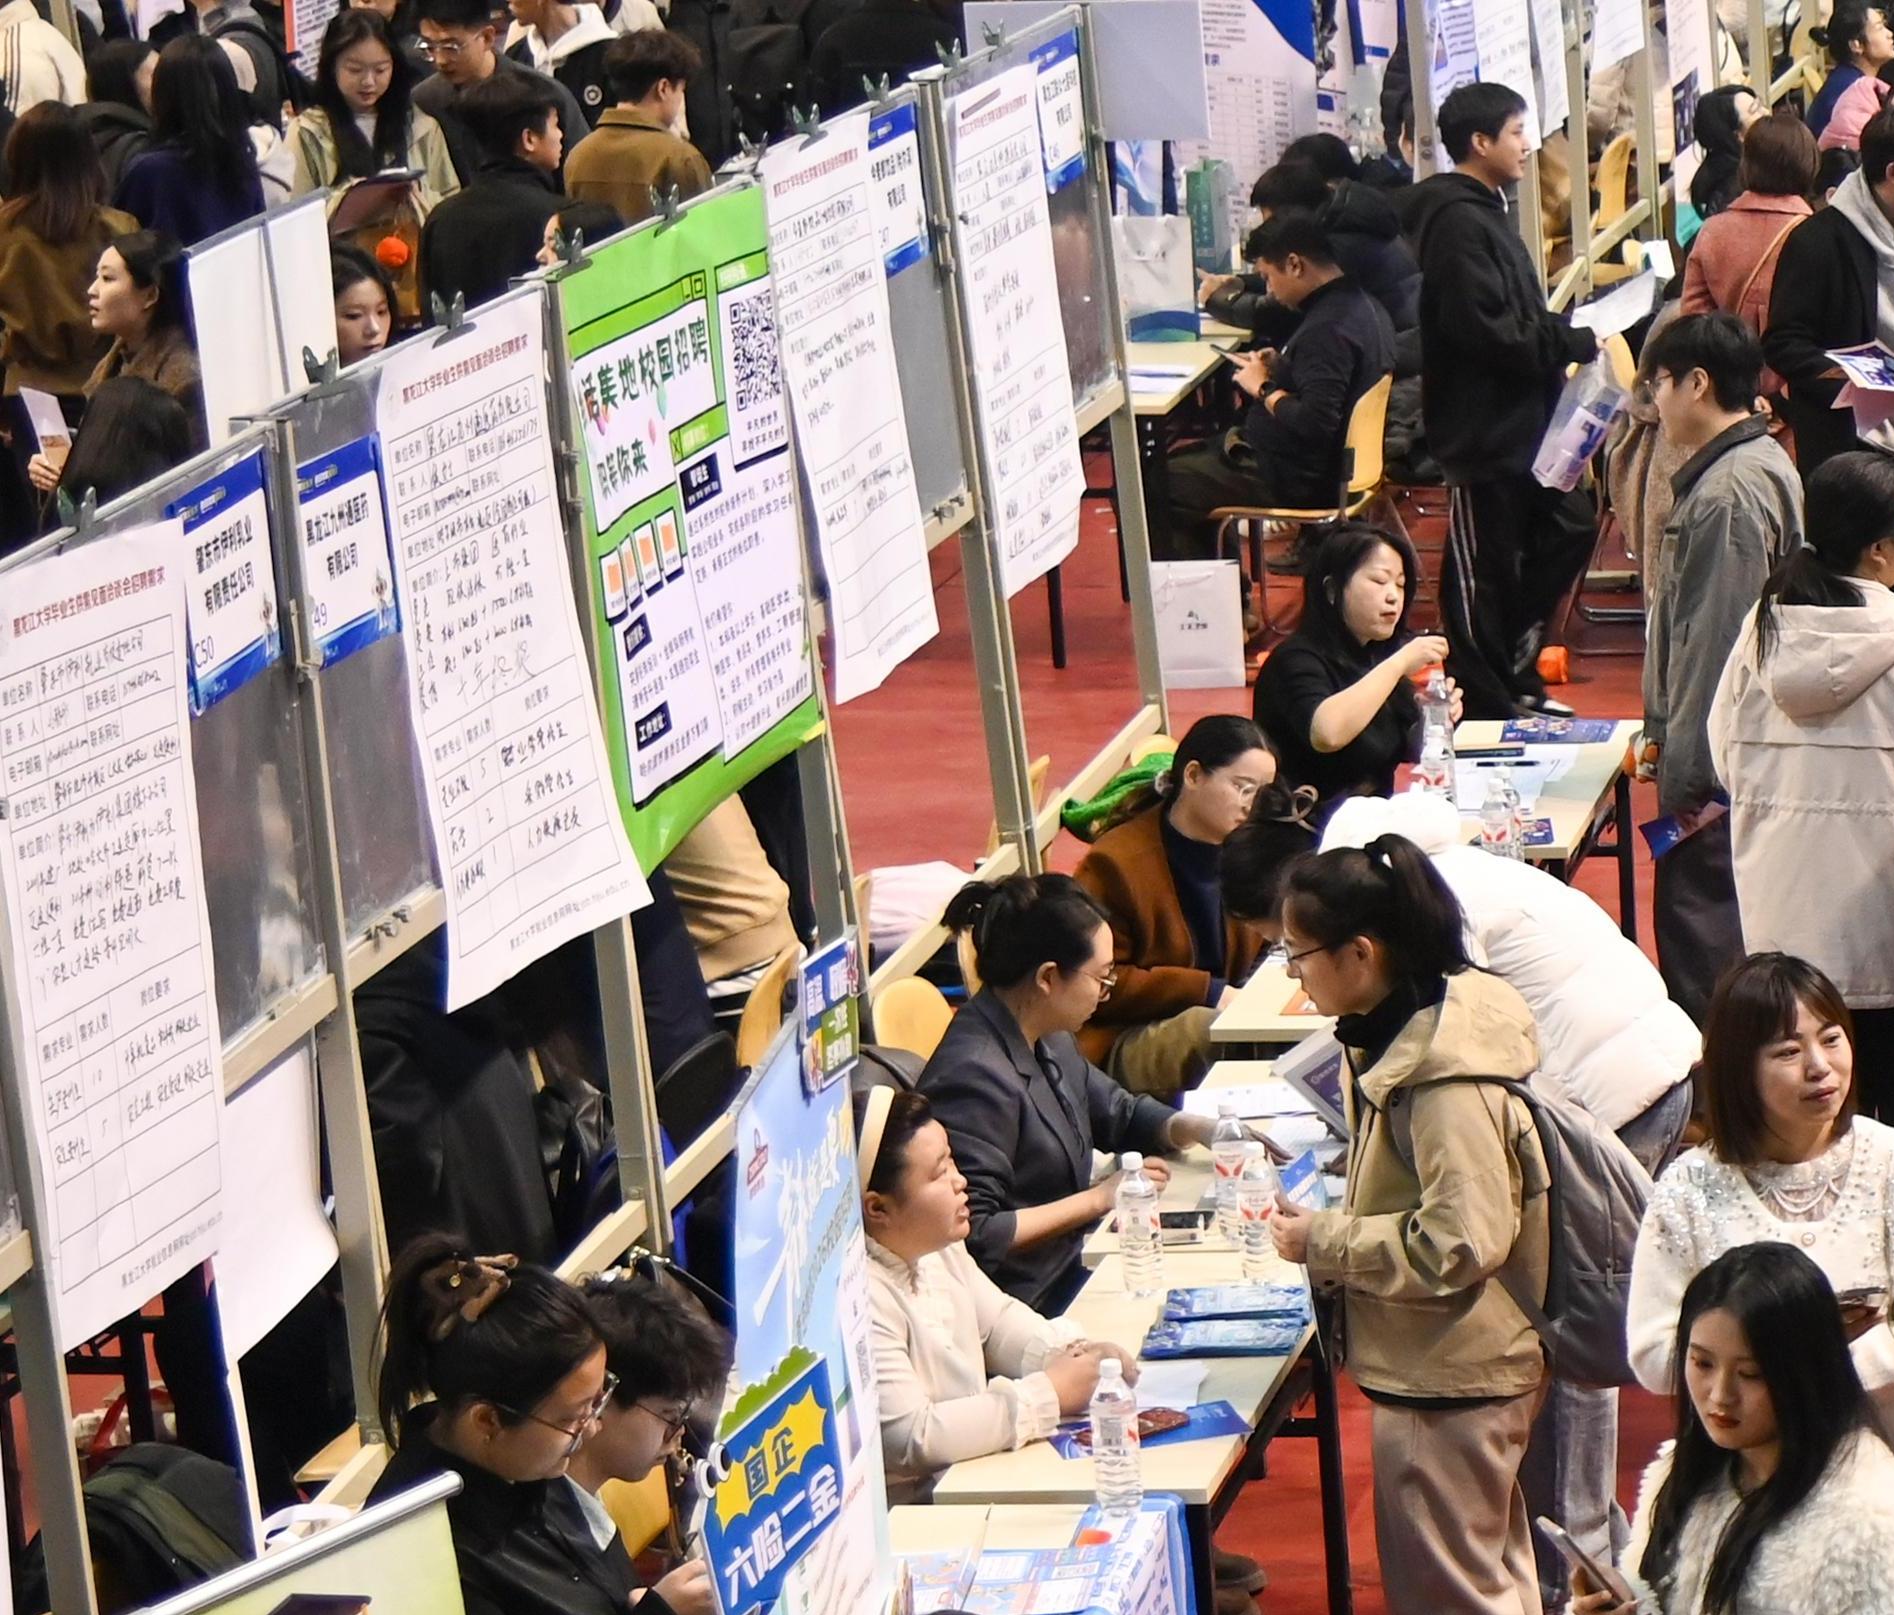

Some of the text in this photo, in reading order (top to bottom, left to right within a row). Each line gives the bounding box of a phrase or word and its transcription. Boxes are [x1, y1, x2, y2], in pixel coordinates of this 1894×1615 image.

[305, 492, 369, 545] 黑龙江九州通医药
[204, 561, 254, 616] 有限责任公司
[326, 542, 359, 582] 有限公司
[745, 1424, 800, 1495] 国企
[721, 1471, 843, 1604] 六险二金
